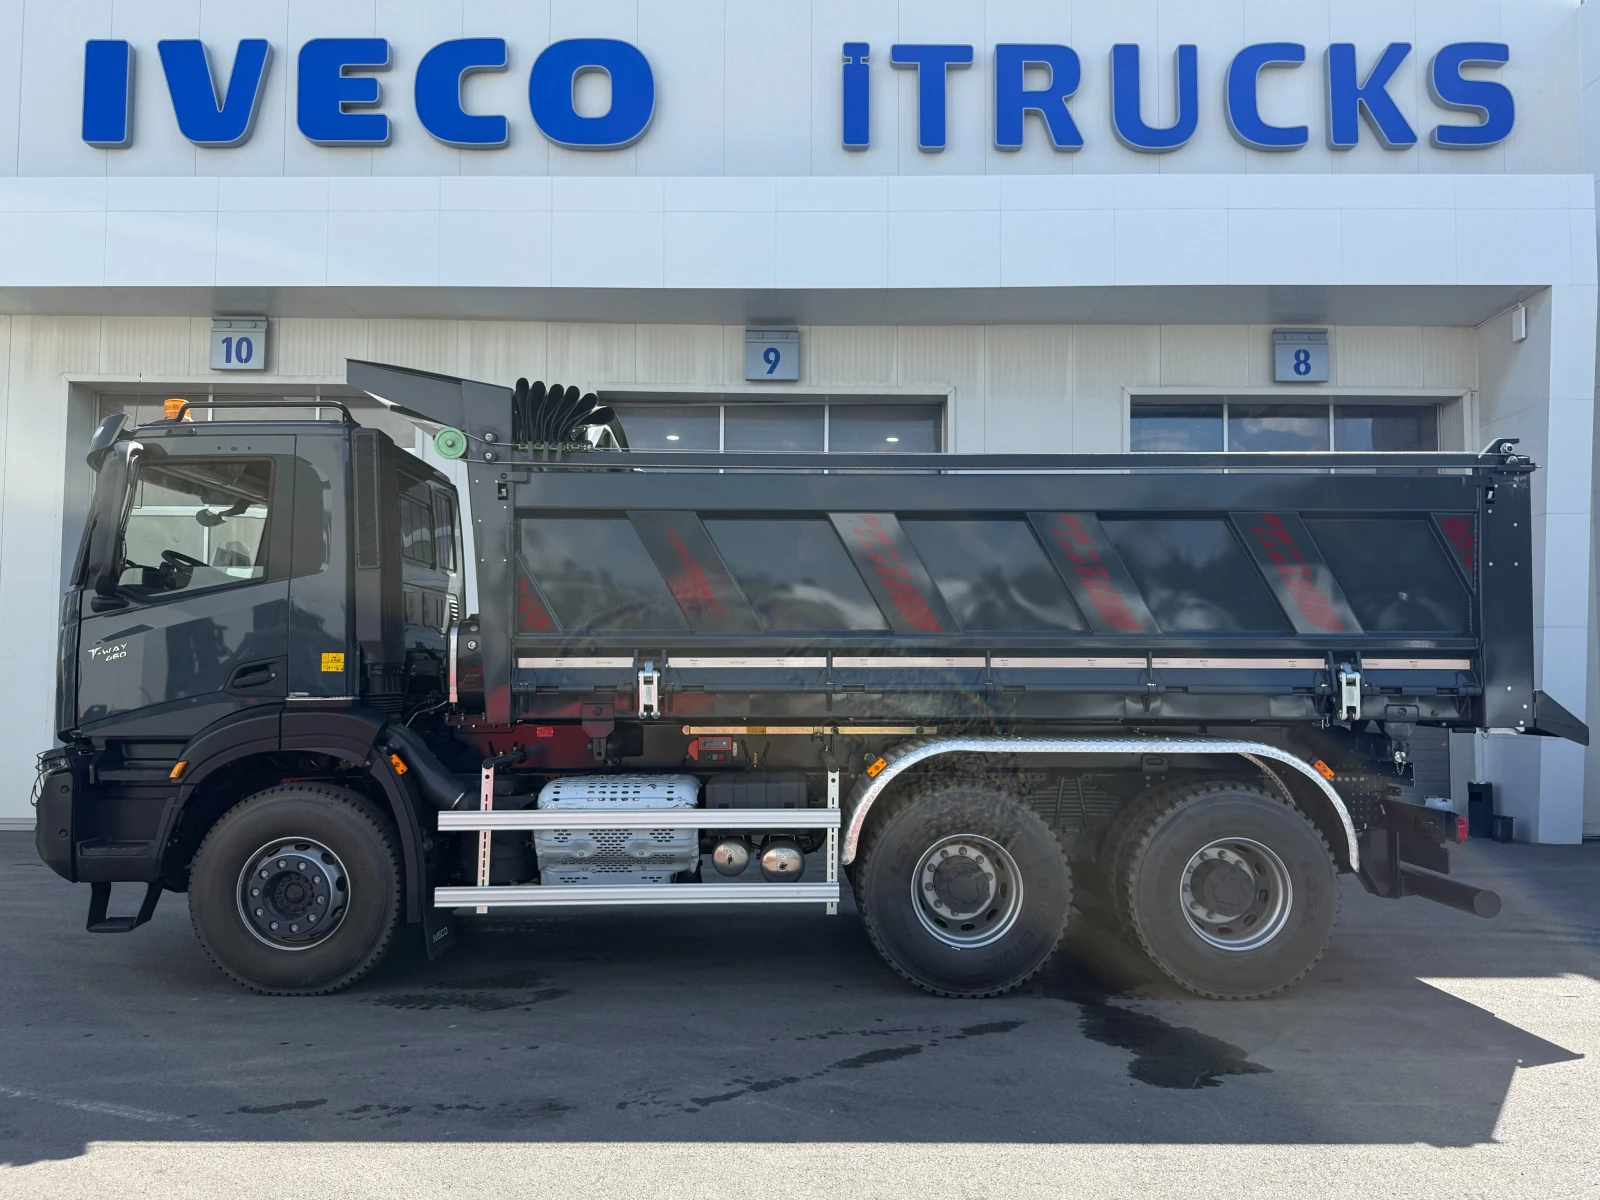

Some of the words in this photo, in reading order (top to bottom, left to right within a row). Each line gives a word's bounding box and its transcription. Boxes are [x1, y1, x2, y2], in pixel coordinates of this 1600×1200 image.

[82, 38, 655, 149] IVECO
[842, 41, 1515, 152] iTRUCKS
[221, 336, 254, 365] 10
[763, 347, 781, 375] 9
[1293, 348, 1312, 376] 8
[87, 642, 128, 661] T-WAY
